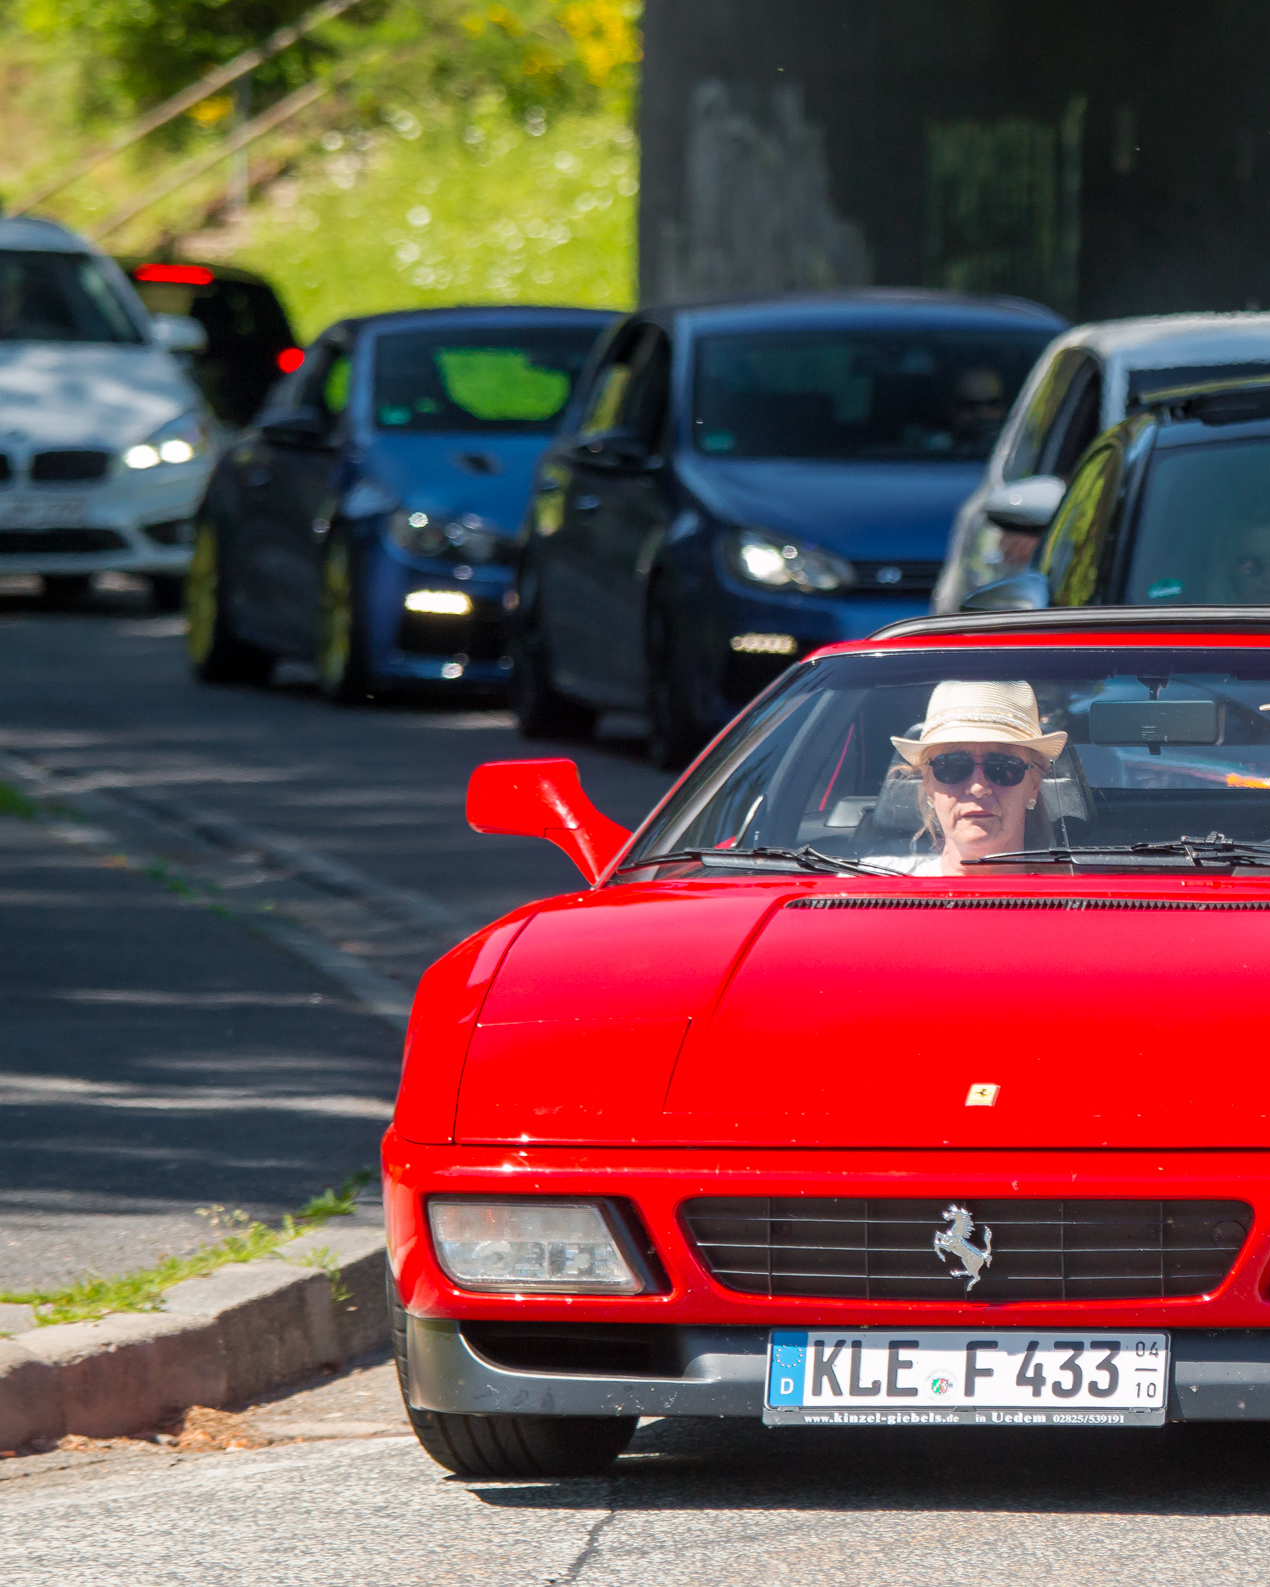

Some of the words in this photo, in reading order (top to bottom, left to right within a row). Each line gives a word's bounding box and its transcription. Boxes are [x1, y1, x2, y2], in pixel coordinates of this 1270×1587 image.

[1135, 1341, 1159, 1358] 04
[812, 1339, 920, 1397] KLE
[964, 1340, 999, 1397] F
[1015, 1340, 1121, 1398] 433
[780, 1378, 794, 1395] D
[1135, 1382, 1157, 1398] 10
[804, 1412, 960, 1425] www.kinzel-giebels.de
[975, 1413, 986, 1423] in
[991, 1412, 1047, 1423] Uedem
[1052, 1413, 1125, 1424] 02825/539191
